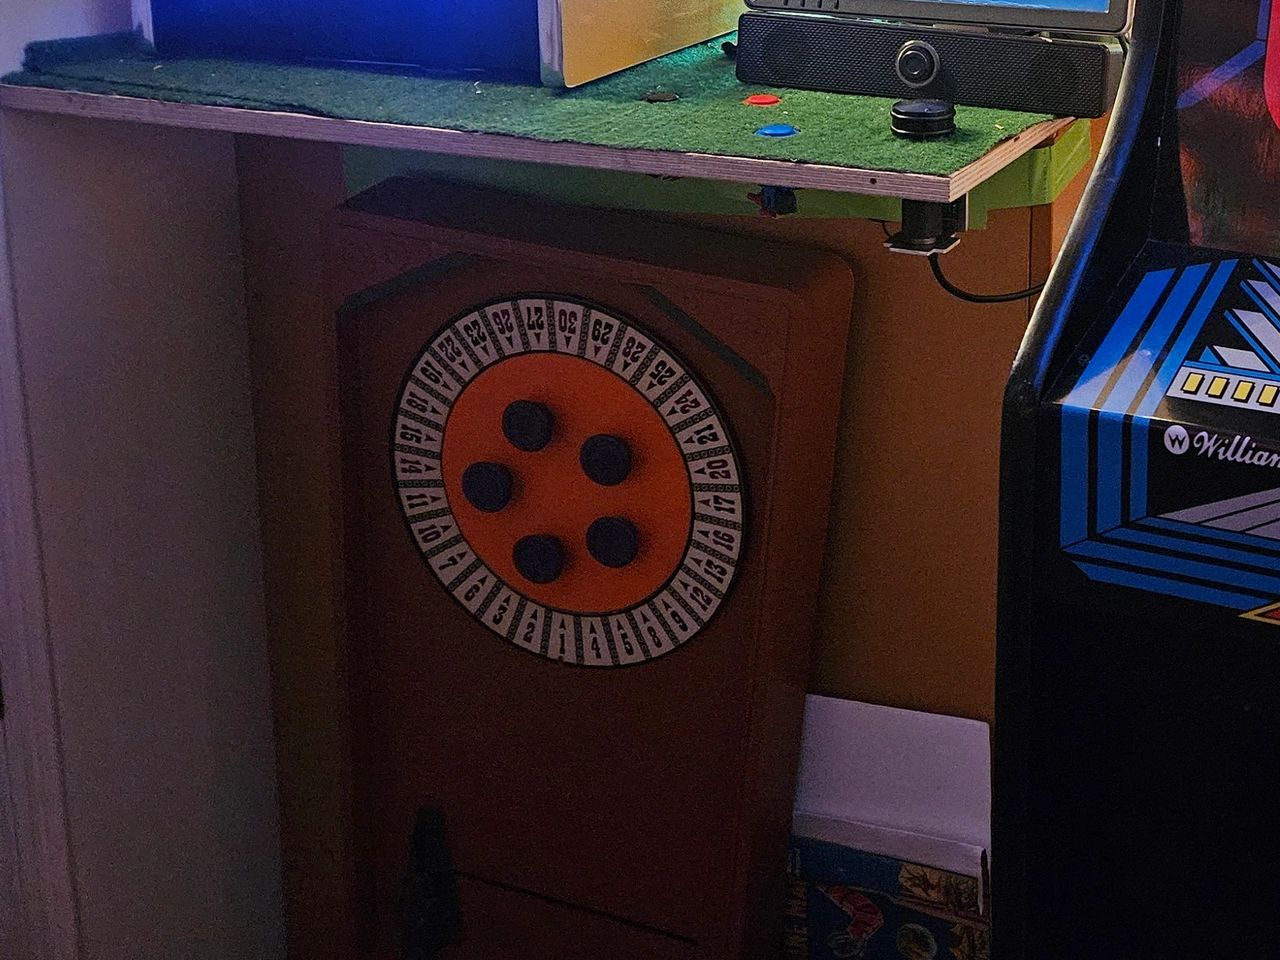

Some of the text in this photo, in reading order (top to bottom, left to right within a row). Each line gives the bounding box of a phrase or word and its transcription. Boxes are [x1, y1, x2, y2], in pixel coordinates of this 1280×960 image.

[491, 308, 515, 335] 26
[525, 306, 546, 331] 27
[558, 309, 578, 334] 30
[462, 318, 488, 347] 23
[591, 318, 614, 346] 29
[436, 335, 464, 364] 22
[622, 336, 647, 363] 28
[419, 359, 445, 386] 19
[649, 359, 677, 387] 25
[405, 390, 430, 414] 18
[674, 388, 701, 416] 24
[399, 423, 424, 445] 15
[693, 423, 720, 446] 21
[399, 458, 423, 475] 14
[706, 459, 732, 481] 20
[405, 493, 430, 510] 11
[713, 494, 736, 515] 17
[417, 523, 442, 545] 10
[712, 529, 735, 552] 16
[437, 555, 459, 571] 7
[703, 558, 728, 585] 13
[462, 585, 482, 603] 6
[689, 585, 714, 613] 12
[491, 606, 506, 626] 3
[522, 622, 536, 644] 2
[646, 625, 663, 649] 8
[591, 636, 602, 659] 4
